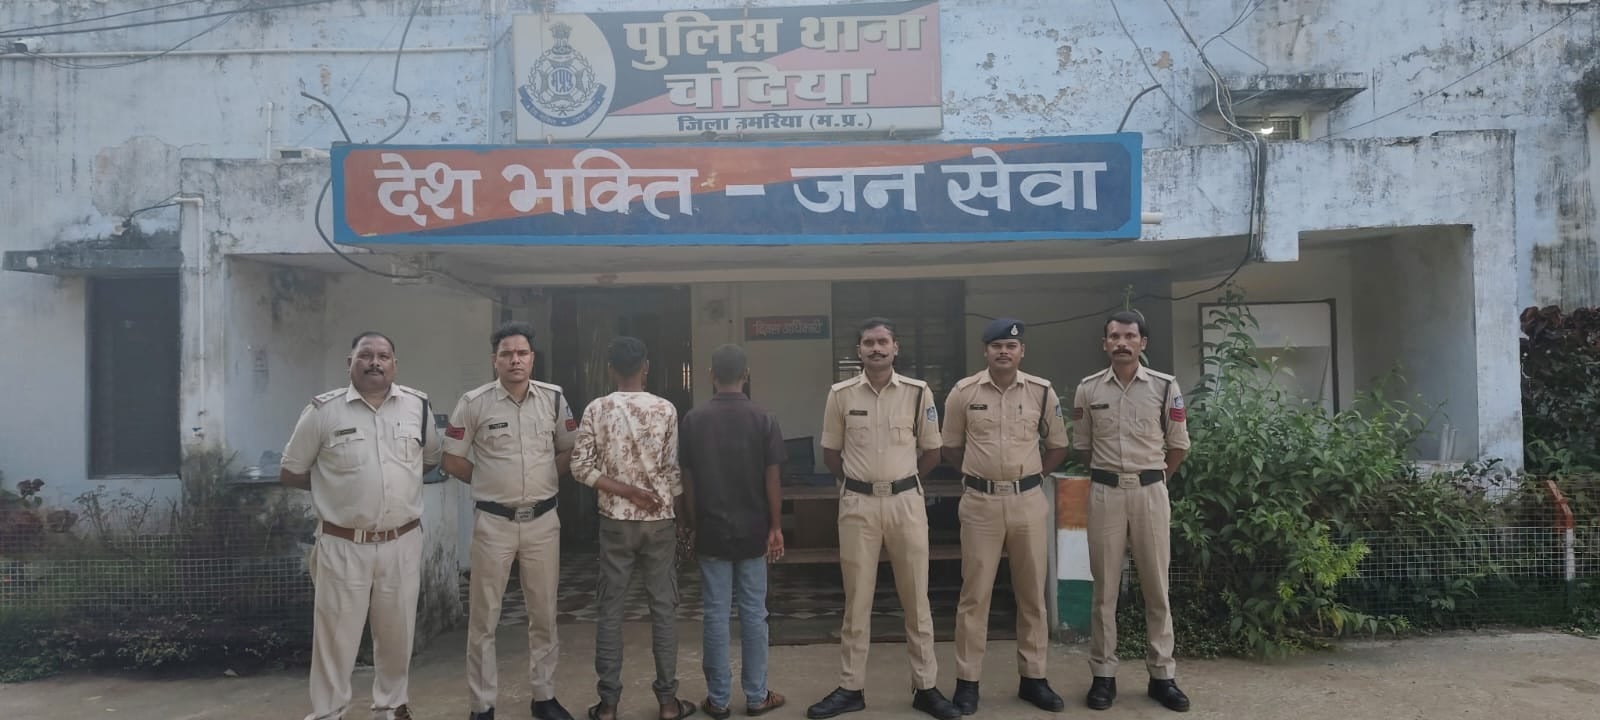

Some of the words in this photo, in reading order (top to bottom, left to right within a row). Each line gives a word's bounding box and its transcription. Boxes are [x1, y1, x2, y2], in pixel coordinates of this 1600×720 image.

[623, 11, 783, 70] पुलिस
[800, 14, 927, 53] थाना
[678, 116, 729, 132] जिला
[809, 112, 872, 130] (म.प्र.)
[374, 153, 481, 226] देश
[502, 149, 698, 220] भक्ति
[790, 165, 924, 213] जन
[941, 147, 1107, 216] सेवा
